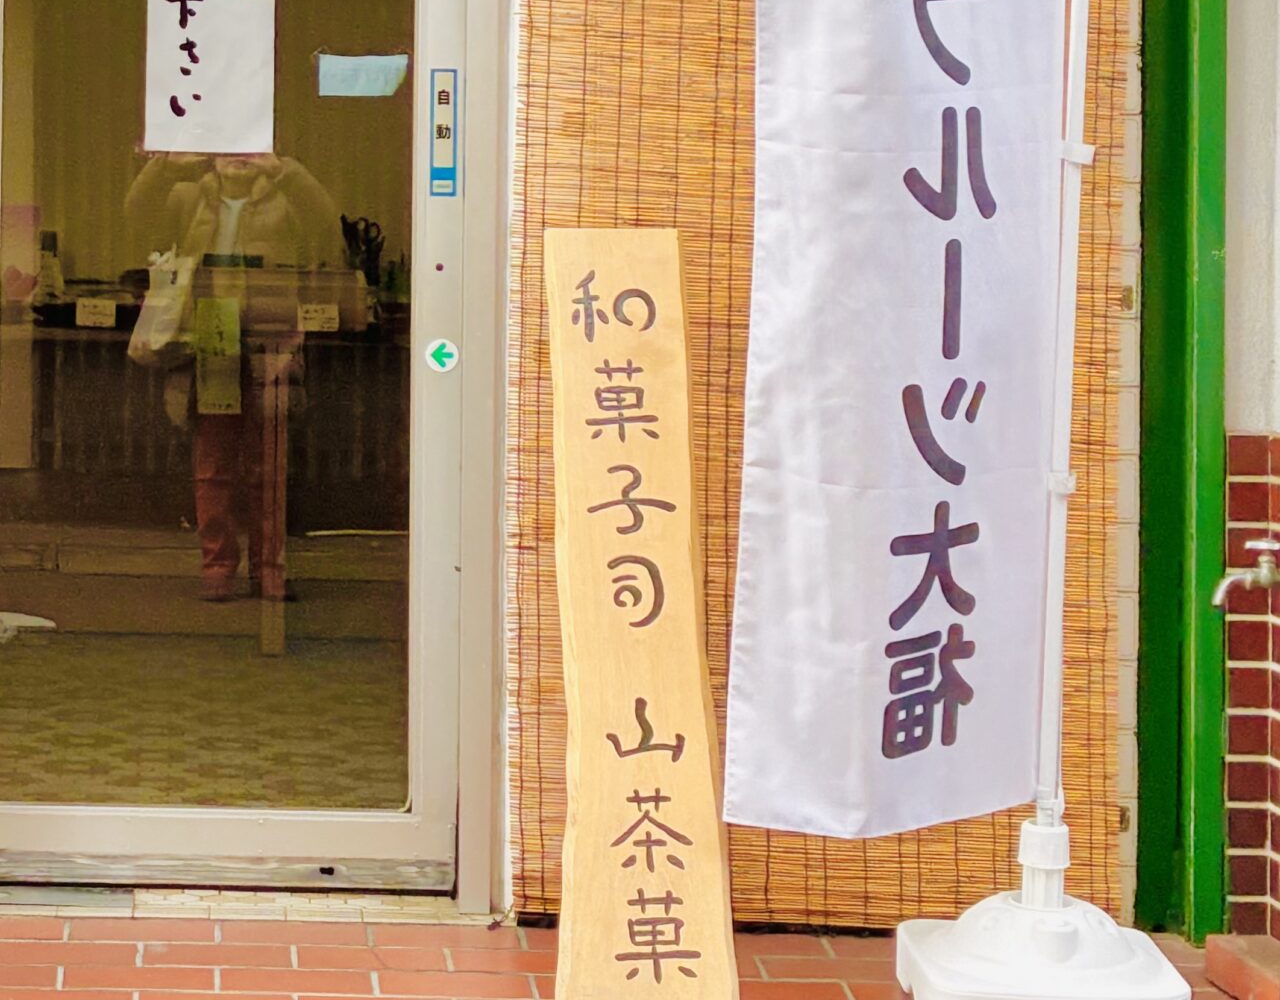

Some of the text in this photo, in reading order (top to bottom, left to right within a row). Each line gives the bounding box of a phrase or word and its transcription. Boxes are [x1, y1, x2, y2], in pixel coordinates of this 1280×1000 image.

[435, 89, 452, 141] 自動
[571, 269, 702, 985] 和菓子司 山茶菓
